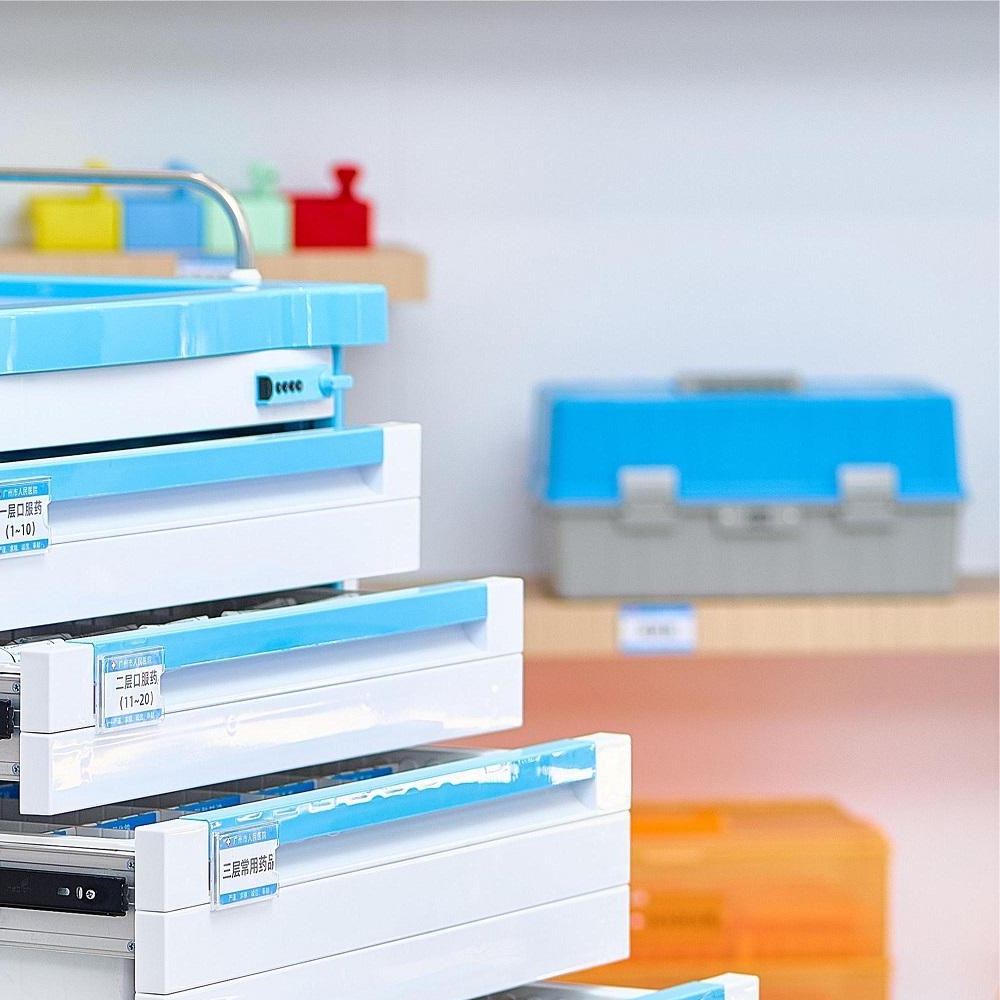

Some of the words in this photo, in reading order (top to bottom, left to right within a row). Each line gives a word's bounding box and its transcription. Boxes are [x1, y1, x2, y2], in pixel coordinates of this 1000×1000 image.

[0, 500, 42, 518] 一层口服药
[6, 521, 35, 539] (1~10)
[115, 669, 158, 690] 二层口服药
[119, 691, 154, 710] (11~20)
[222, 853, 274, 879] 三层常用药品
